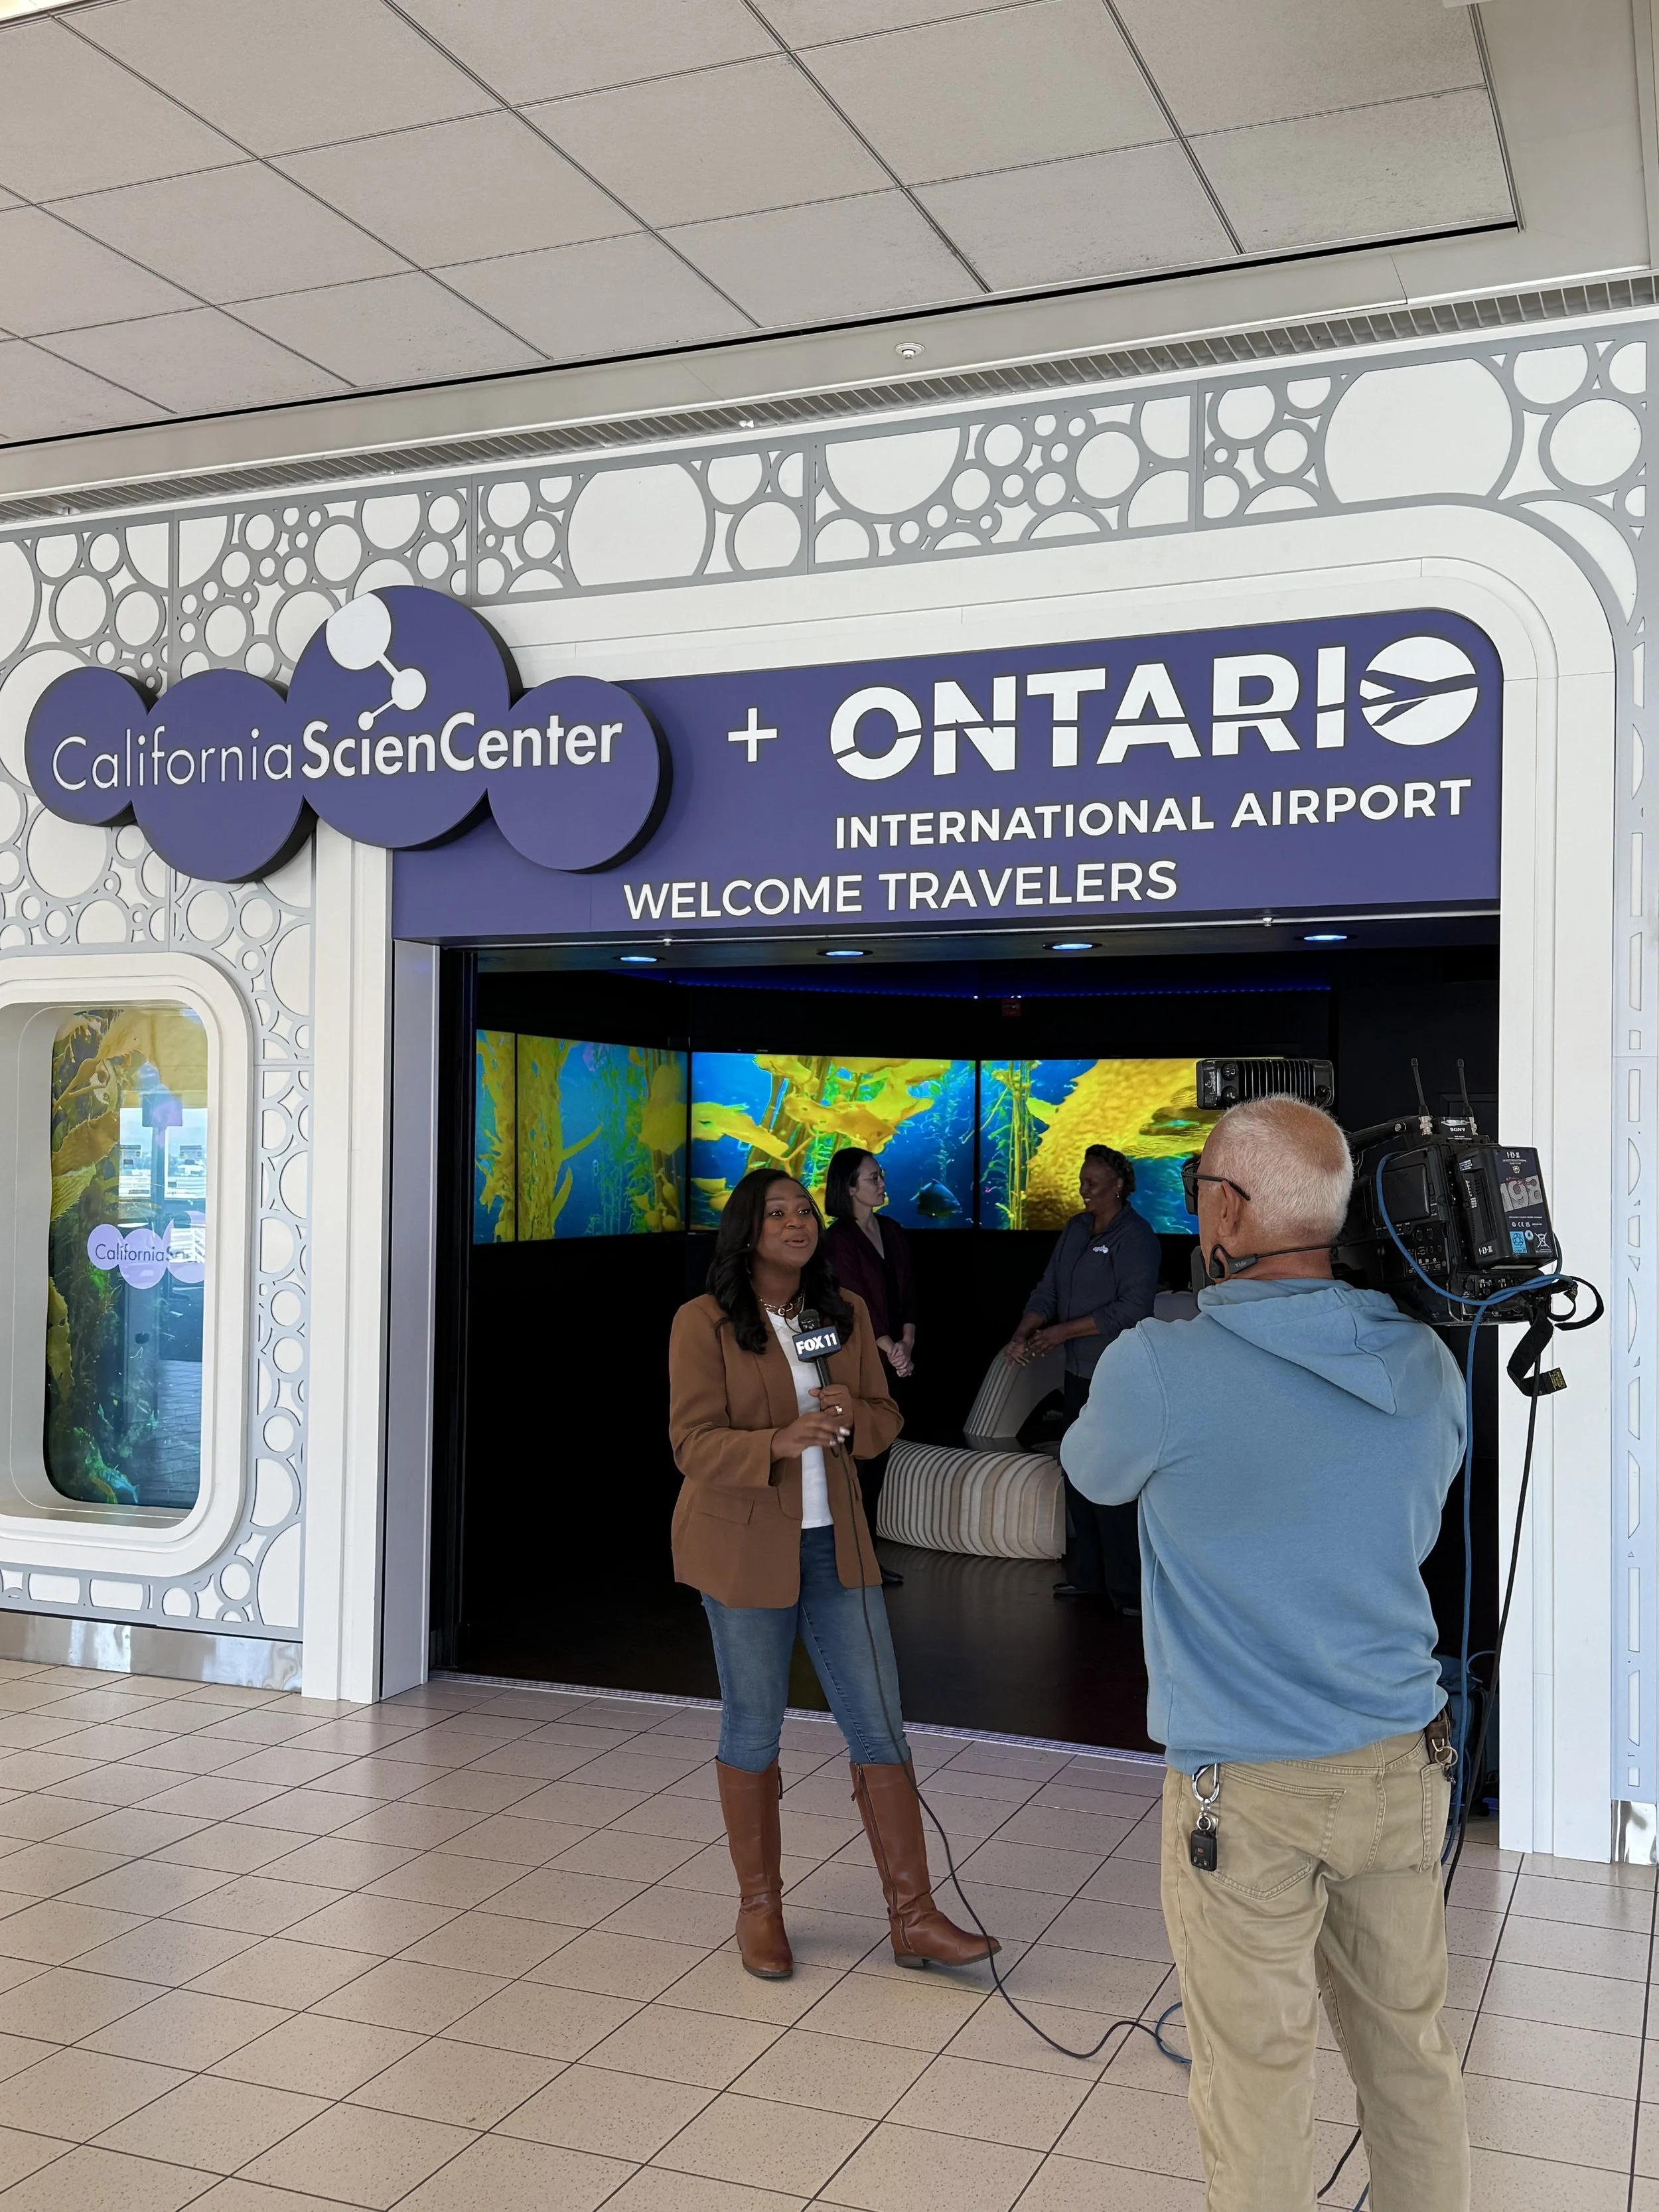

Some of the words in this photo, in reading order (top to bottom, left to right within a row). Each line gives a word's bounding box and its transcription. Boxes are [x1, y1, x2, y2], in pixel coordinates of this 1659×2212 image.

[830, 636, 1479, 780] ONTARIO
[836, 795, 1215, 849] INTERNATIONAL
[1230, 778, 1472, 828] AIRPORT
[622, 874, 863, 920] WELCOME
[877, 859, 1177, 911] TRAVELERS
[95, 1243, 165, 1262] California
[796, 1335, 825, 1355] FOX
[824, 1333, 837, 1347] 11
